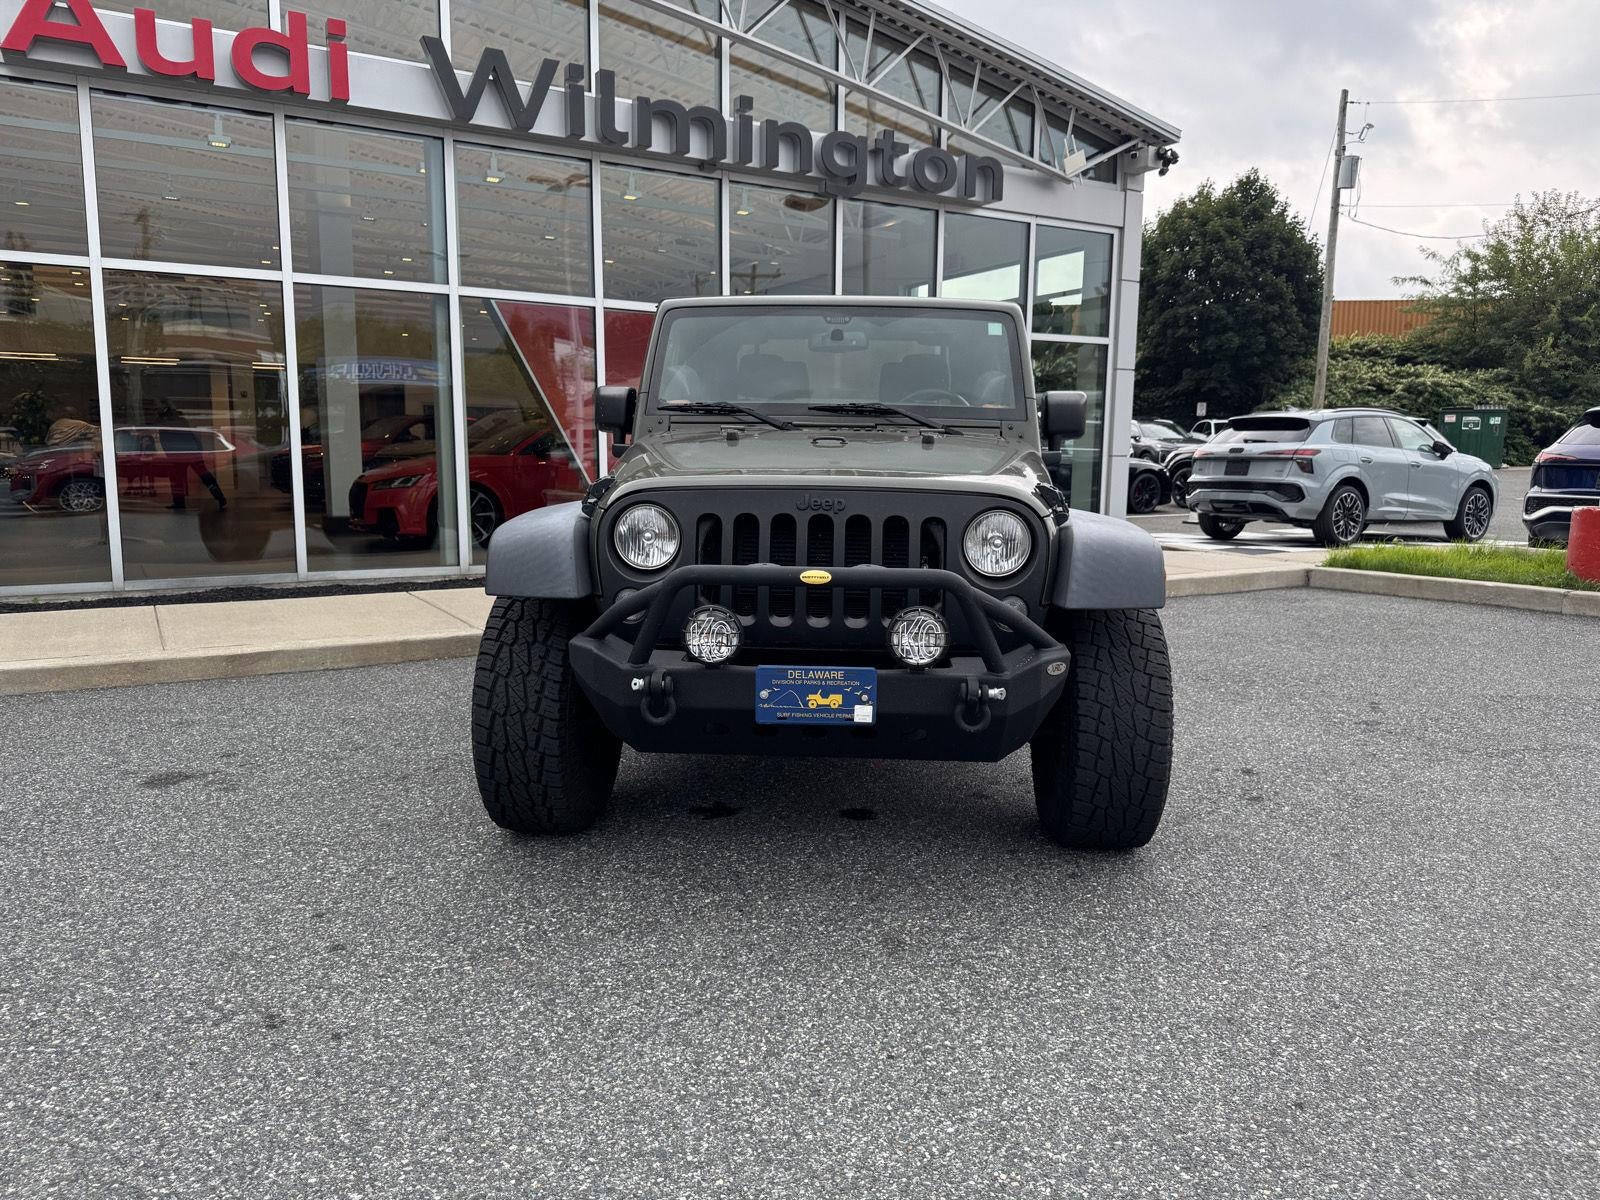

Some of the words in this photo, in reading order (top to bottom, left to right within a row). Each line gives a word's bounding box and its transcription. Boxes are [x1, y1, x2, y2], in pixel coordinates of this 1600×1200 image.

[2, 0, 350, 101] Audi
[419, 35, 1004, 202] Wilmington
[796, 494, 846, 514] Jeep
[690, 617, 732, 662] KC
[900, 616, 942, 661] KC
[787, 670, 845, 679] DELAWARE
